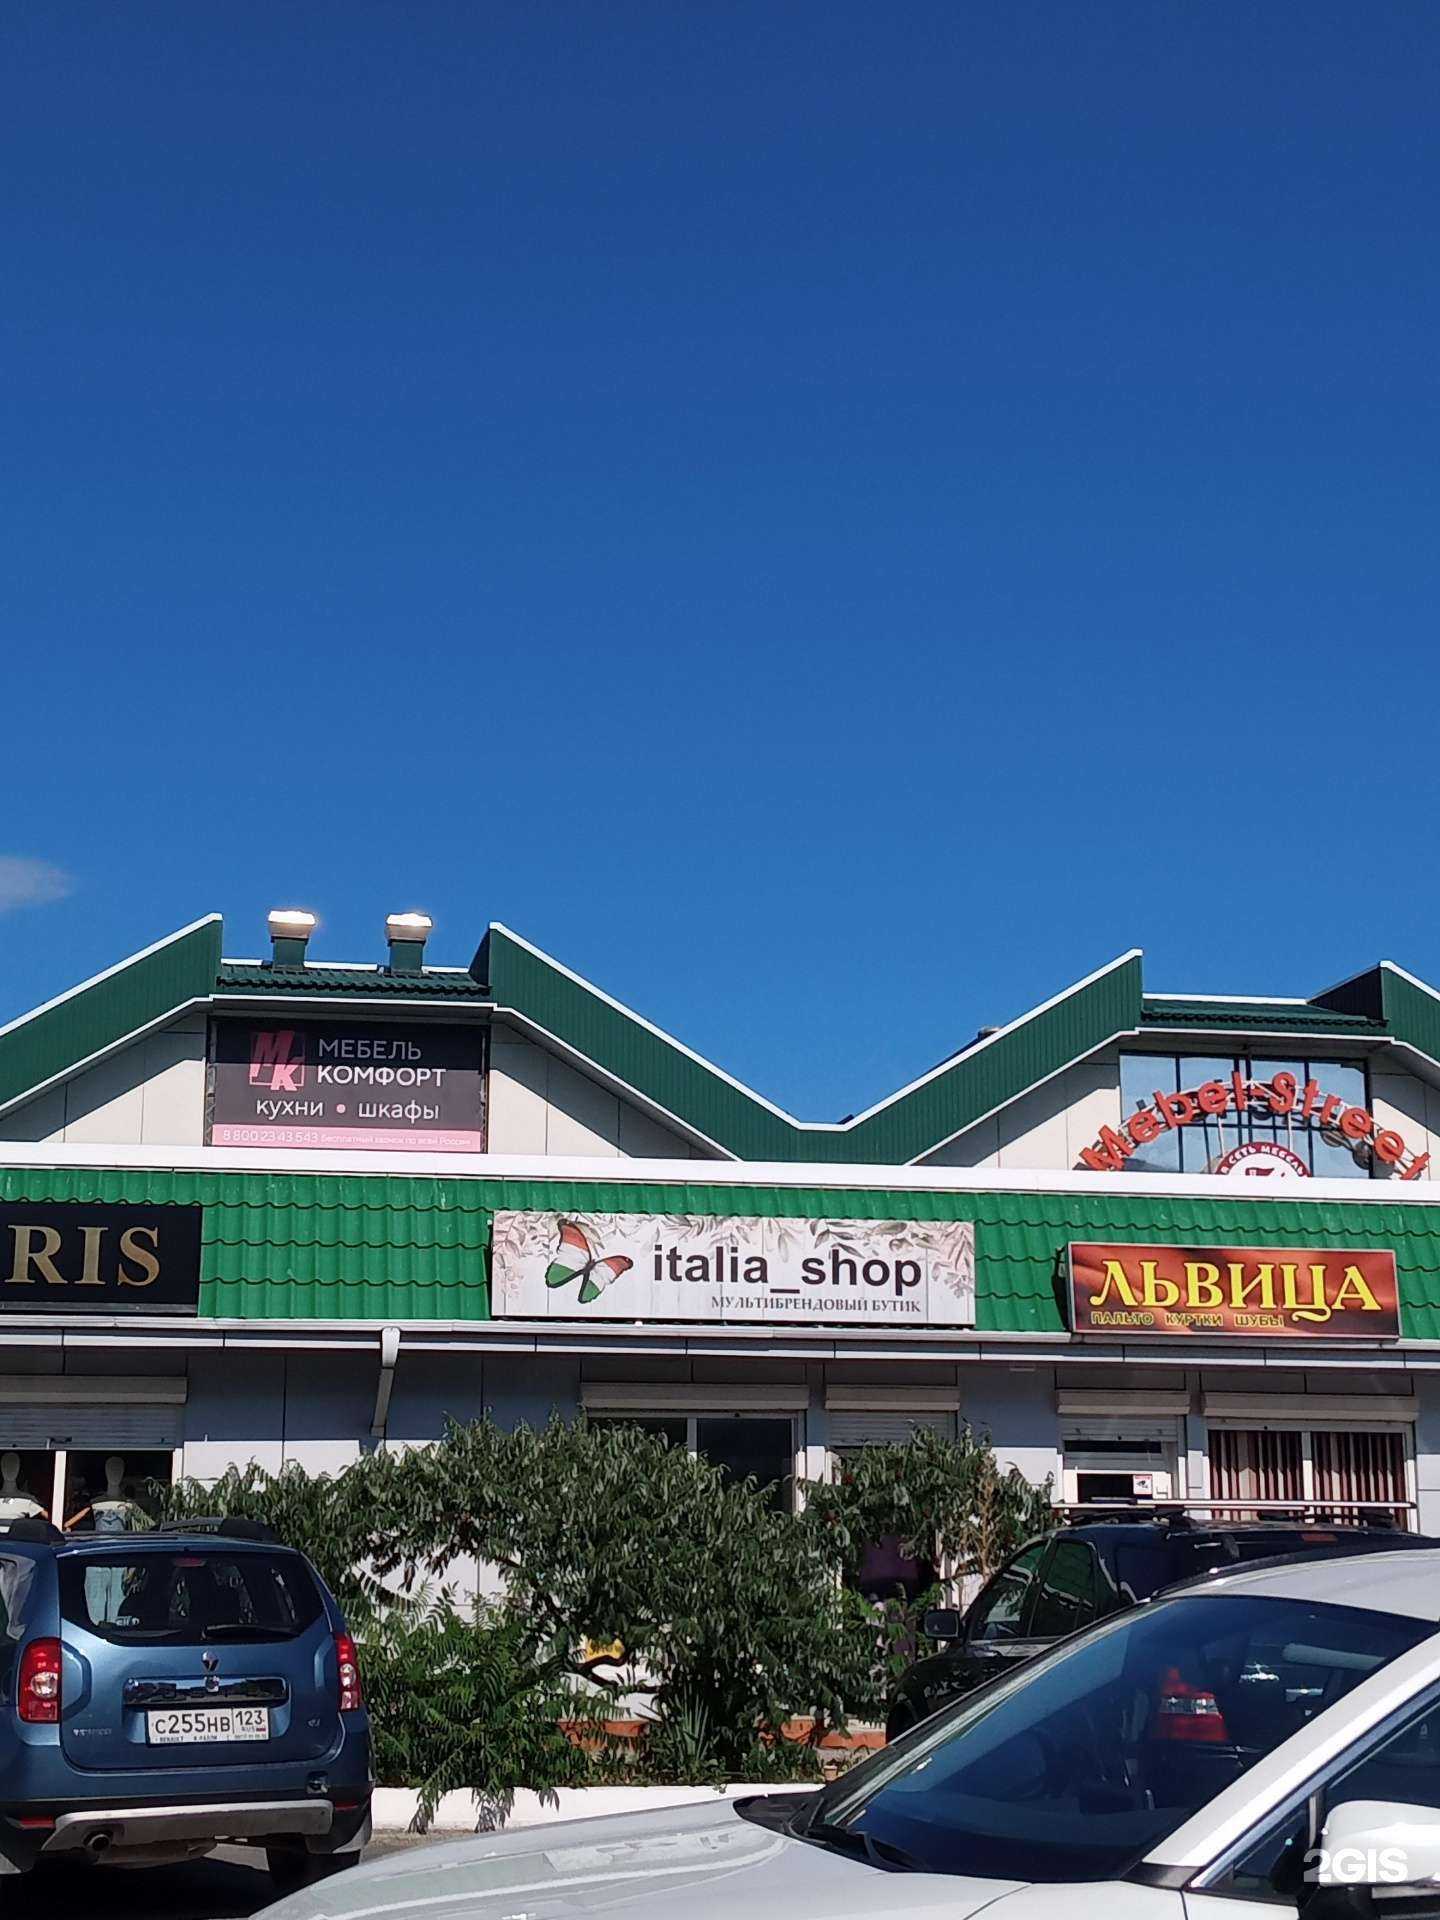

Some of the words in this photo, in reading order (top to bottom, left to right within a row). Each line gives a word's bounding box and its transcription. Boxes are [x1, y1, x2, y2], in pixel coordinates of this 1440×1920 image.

[318, 1038, 422, 1060] МЕБЕЛЬ
[316, 1064, 447, 1087] КОМФОРТ
[256, 1099, 324, 1120] кухни
[358, 1100, 440, 1124] шкафы
[4, 1225, 161, 1286] RIS
[653, 1245, 922, 1296] italia_shop
[1089, 1259, 1382, 1322] ЛЬВИЦА
[711, 1295, 869, 1313] МУЛЬТИБРЕНДОВЫЙ
[872, 1298, 922, 1313] БУТИК
[1091, 1311, 1154, 1326] ПАЛЬТО
[1164, 1312, 1224, 1326] КУРТКИ
[1234, 1313, 1285, 1327] ШУБЫ
[155, 1713, 231, 1734] С255НВ
[235, 1710, 263, 1726] 123
